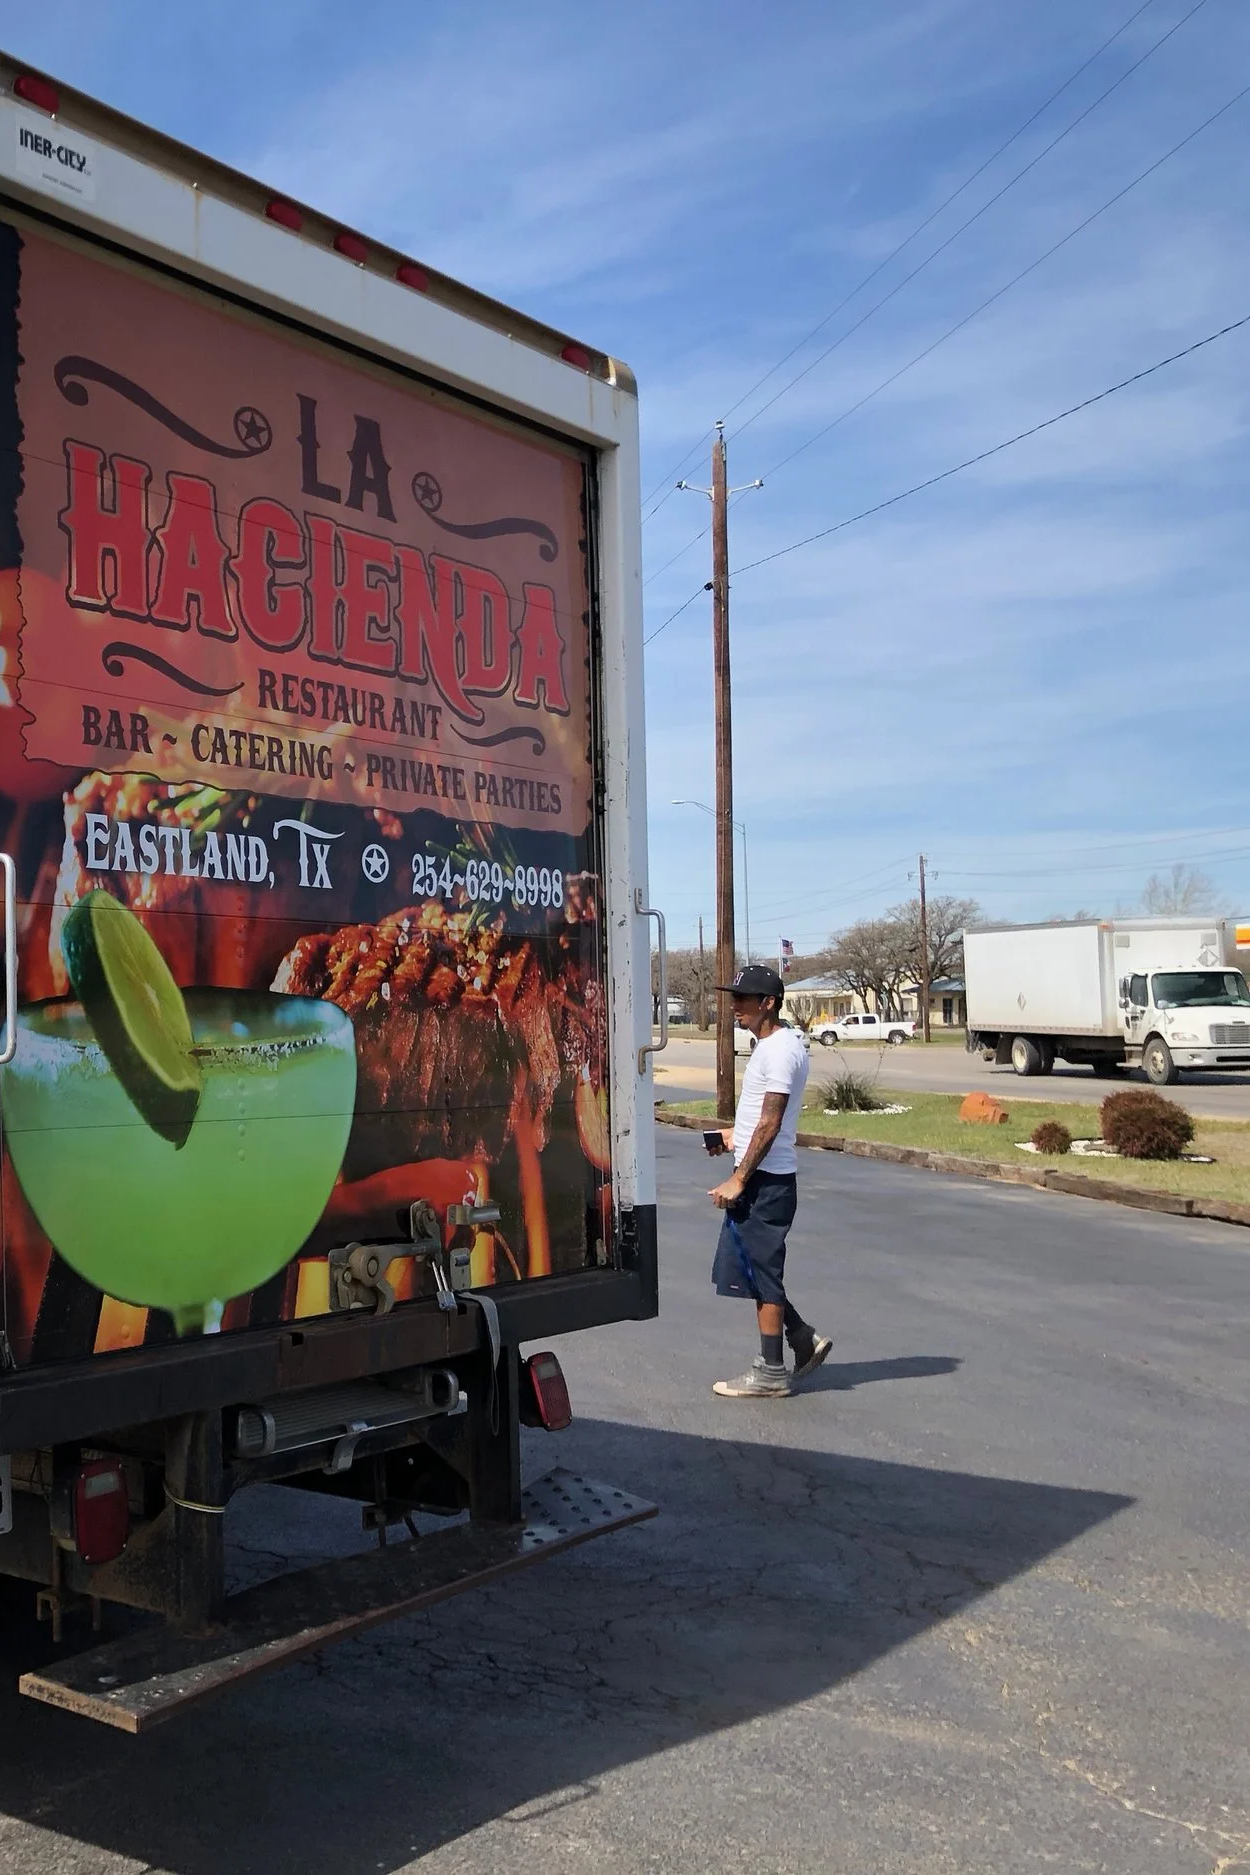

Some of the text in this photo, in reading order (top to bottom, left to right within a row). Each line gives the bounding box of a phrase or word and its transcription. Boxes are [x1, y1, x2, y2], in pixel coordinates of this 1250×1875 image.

[296, 393, 397, 523] LA
[57, 438, 570, 726] HACIENDA
[81, 704, 154, 755] BAR
[189, 723, 334, 781] CATERING
[365, 753, 467, 801] PRIVATE
[473, 771, 562, 816] PARTIES
[257, 669, 443, 741] RESTAURANT
